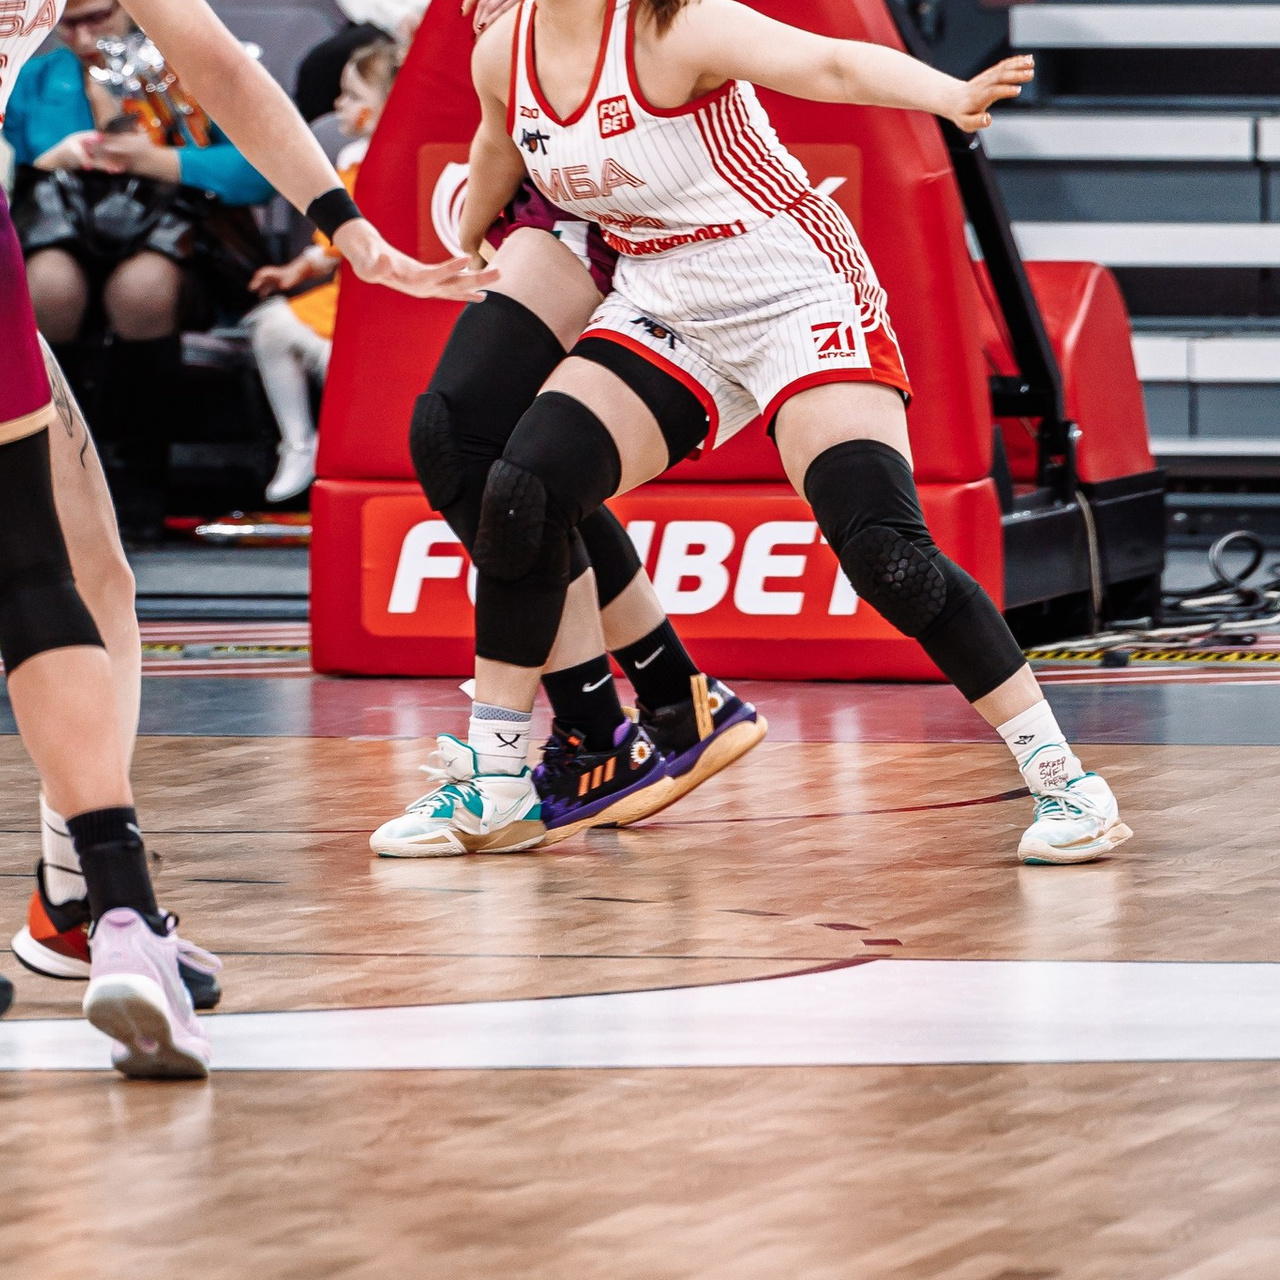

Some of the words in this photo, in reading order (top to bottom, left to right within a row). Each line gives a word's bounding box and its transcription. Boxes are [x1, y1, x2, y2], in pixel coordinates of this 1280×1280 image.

[600, 98, 627, 119] FON
[601, 113, 630, 135] BET
[531, 158, 647, 202] МБА
[387, 520, 863, 615] FBET
